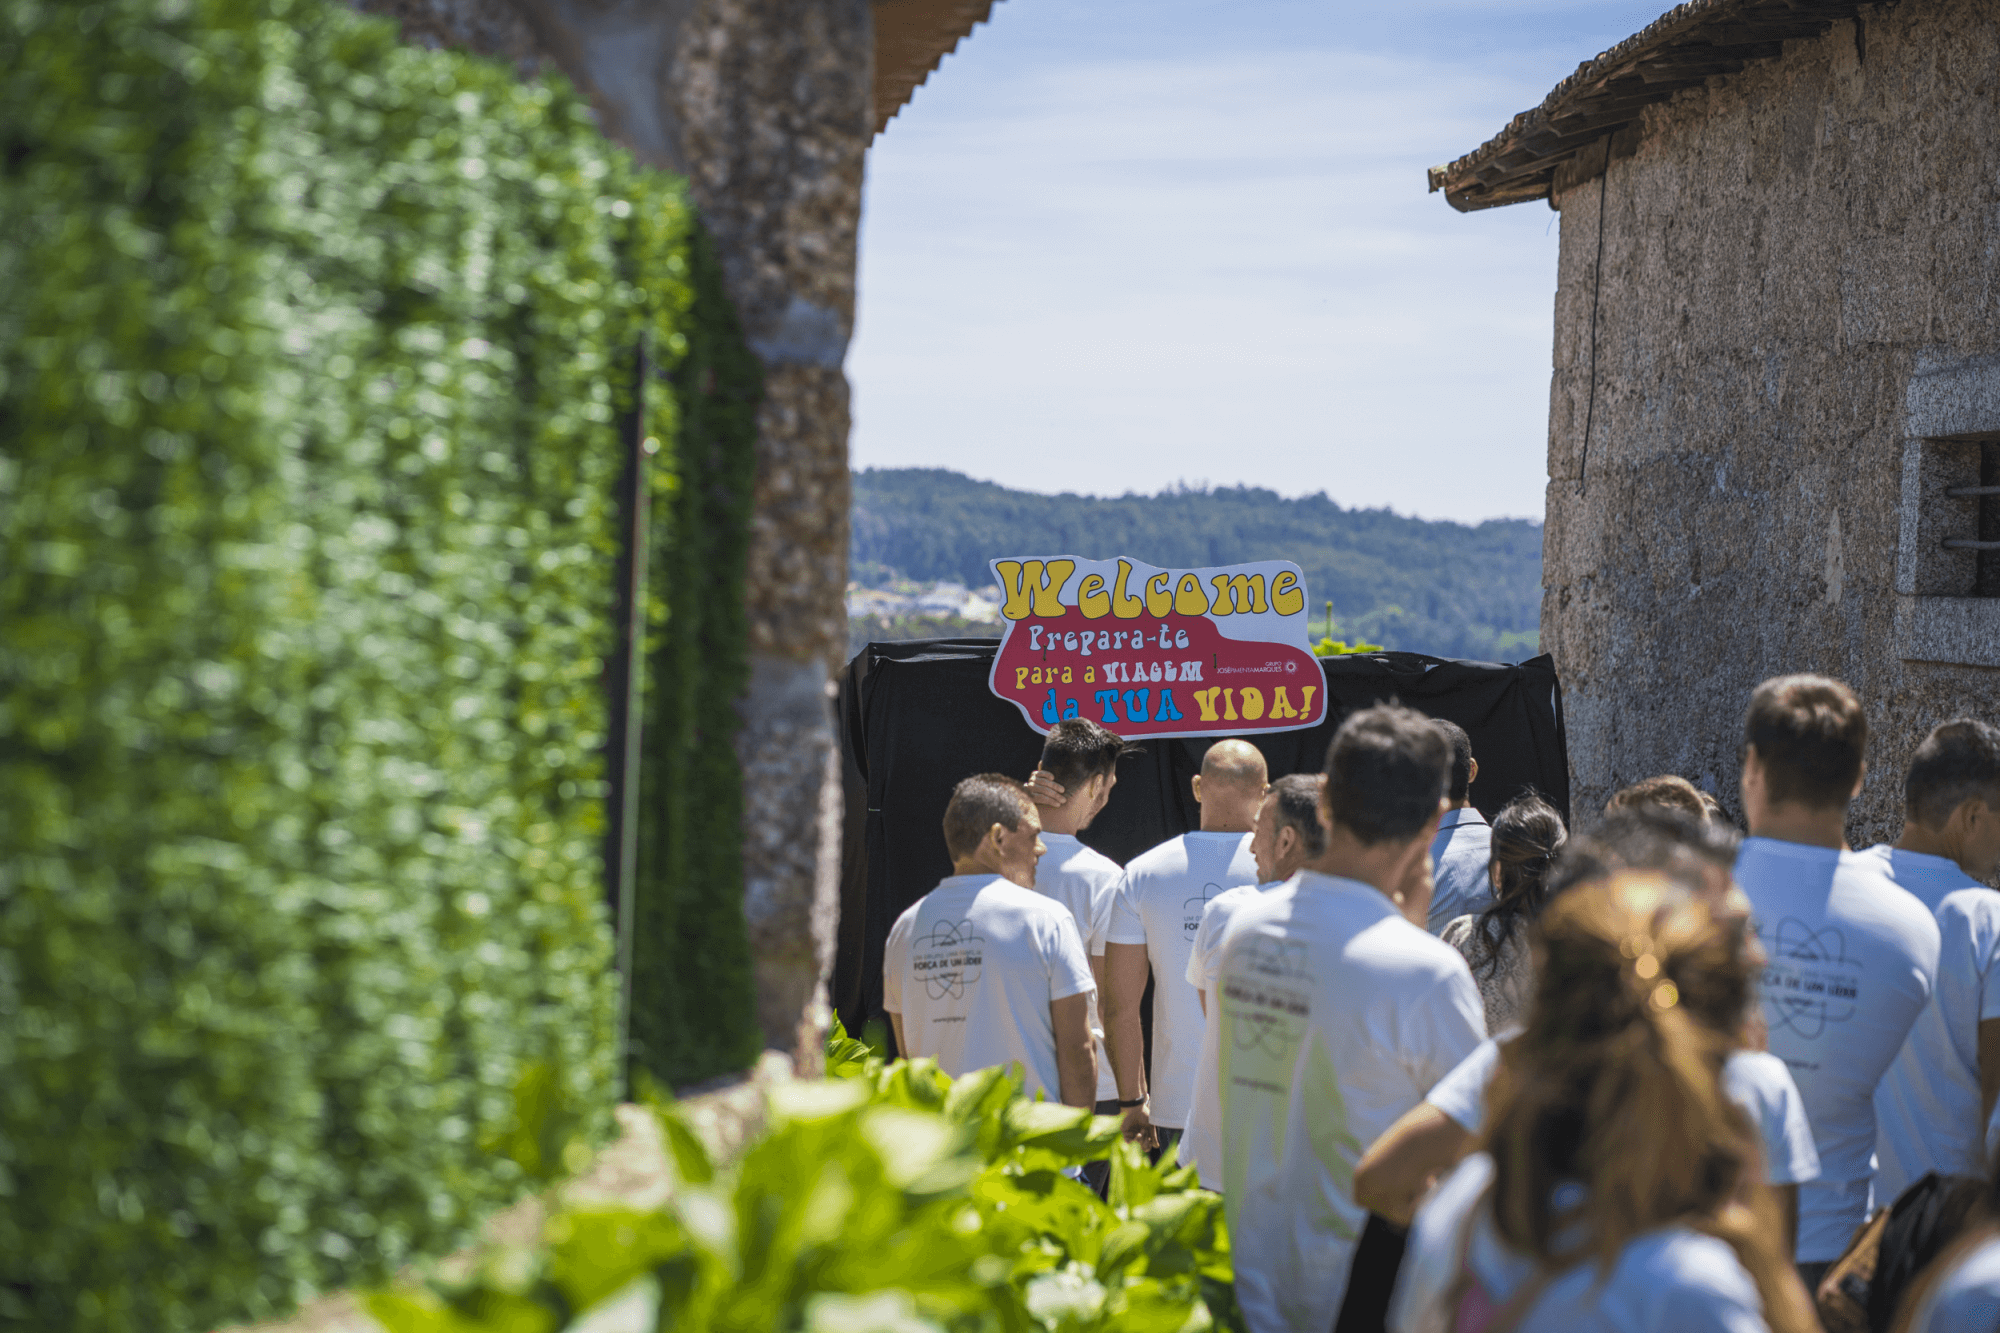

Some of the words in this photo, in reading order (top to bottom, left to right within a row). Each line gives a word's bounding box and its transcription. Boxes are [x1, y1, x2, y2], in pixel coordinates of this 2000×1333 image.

[1029, 623, 1190, 656] Prepara-te
[1015, 666, 1074, 690] para
[1083, 665, 1096, 684] a
[1102, 660, 1204, 683] VIAGEM
[1042, 688, 1079, 724] da
[1094, 687, 1184, 723] TUA
[1193, 686, 1317, 721] VIDA!
